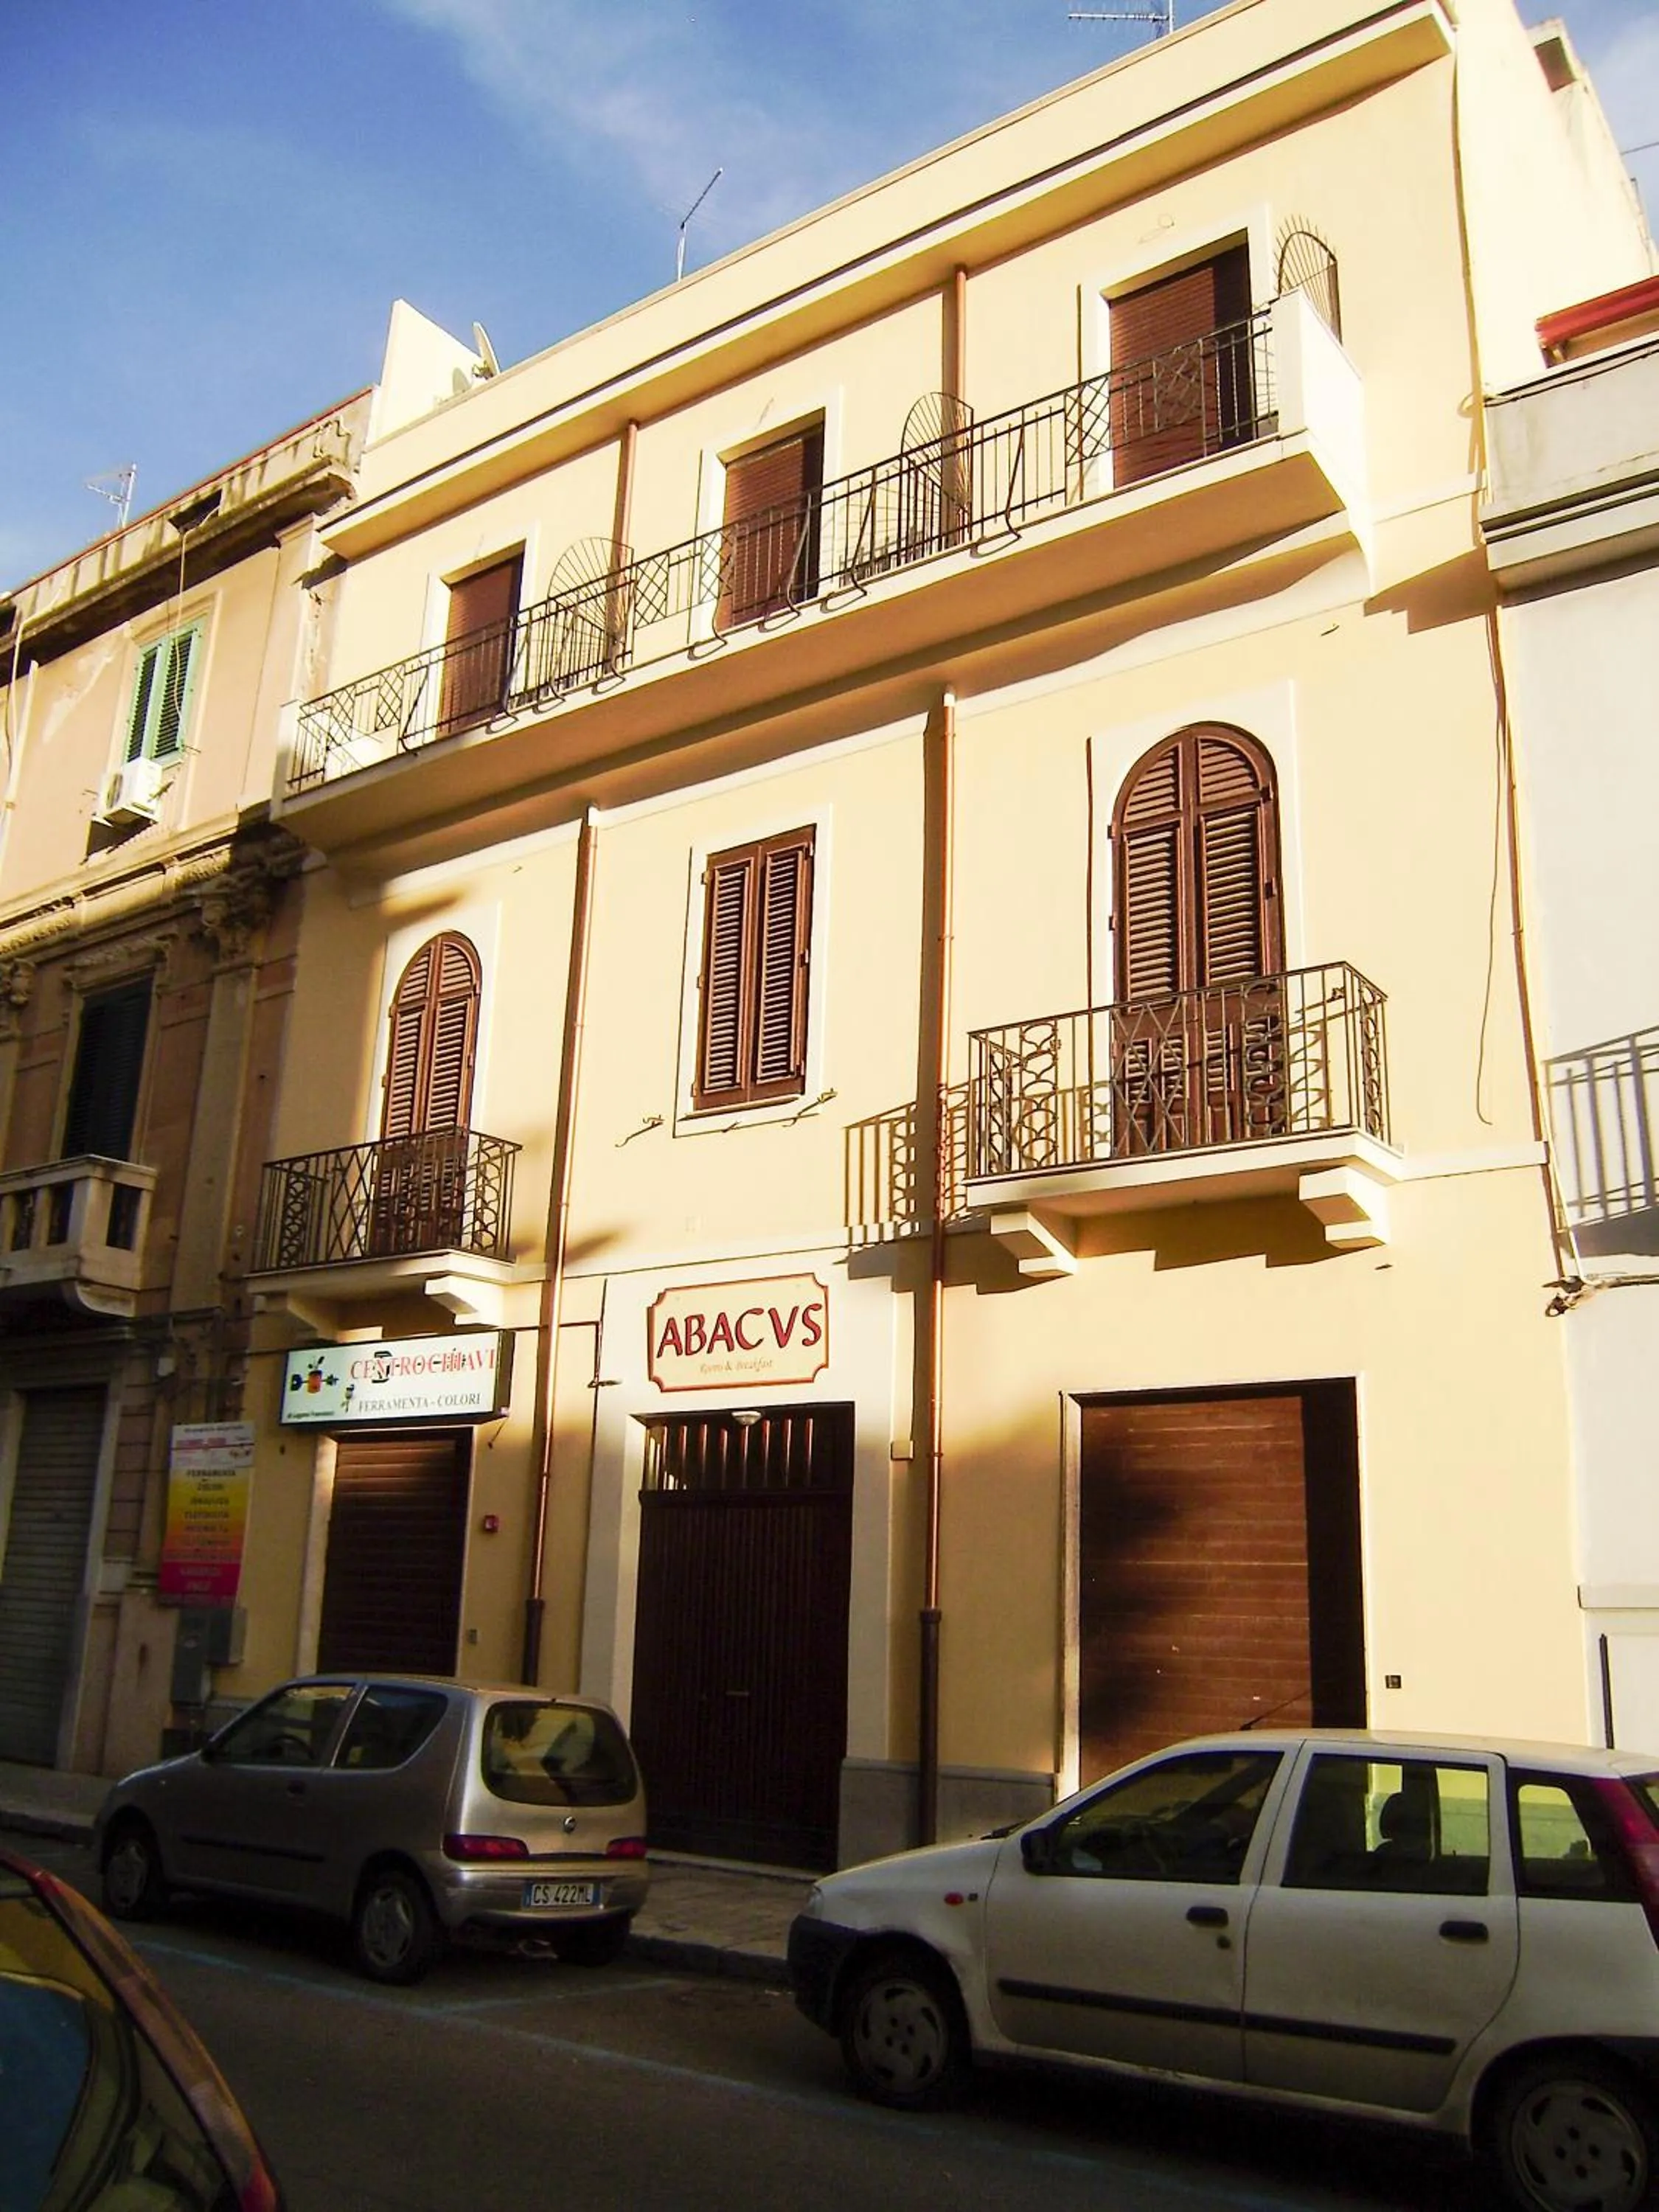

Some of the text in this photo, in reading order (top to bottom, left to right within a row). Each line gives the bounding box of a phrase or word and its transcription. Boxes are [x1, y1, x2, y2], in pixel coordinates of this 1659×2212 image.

[656, 1303, 823, 1358] ABACVS
[358, 1395, 429, 1413] FERRAMENTA
[437, 1393, 481, 1408] COLORI
